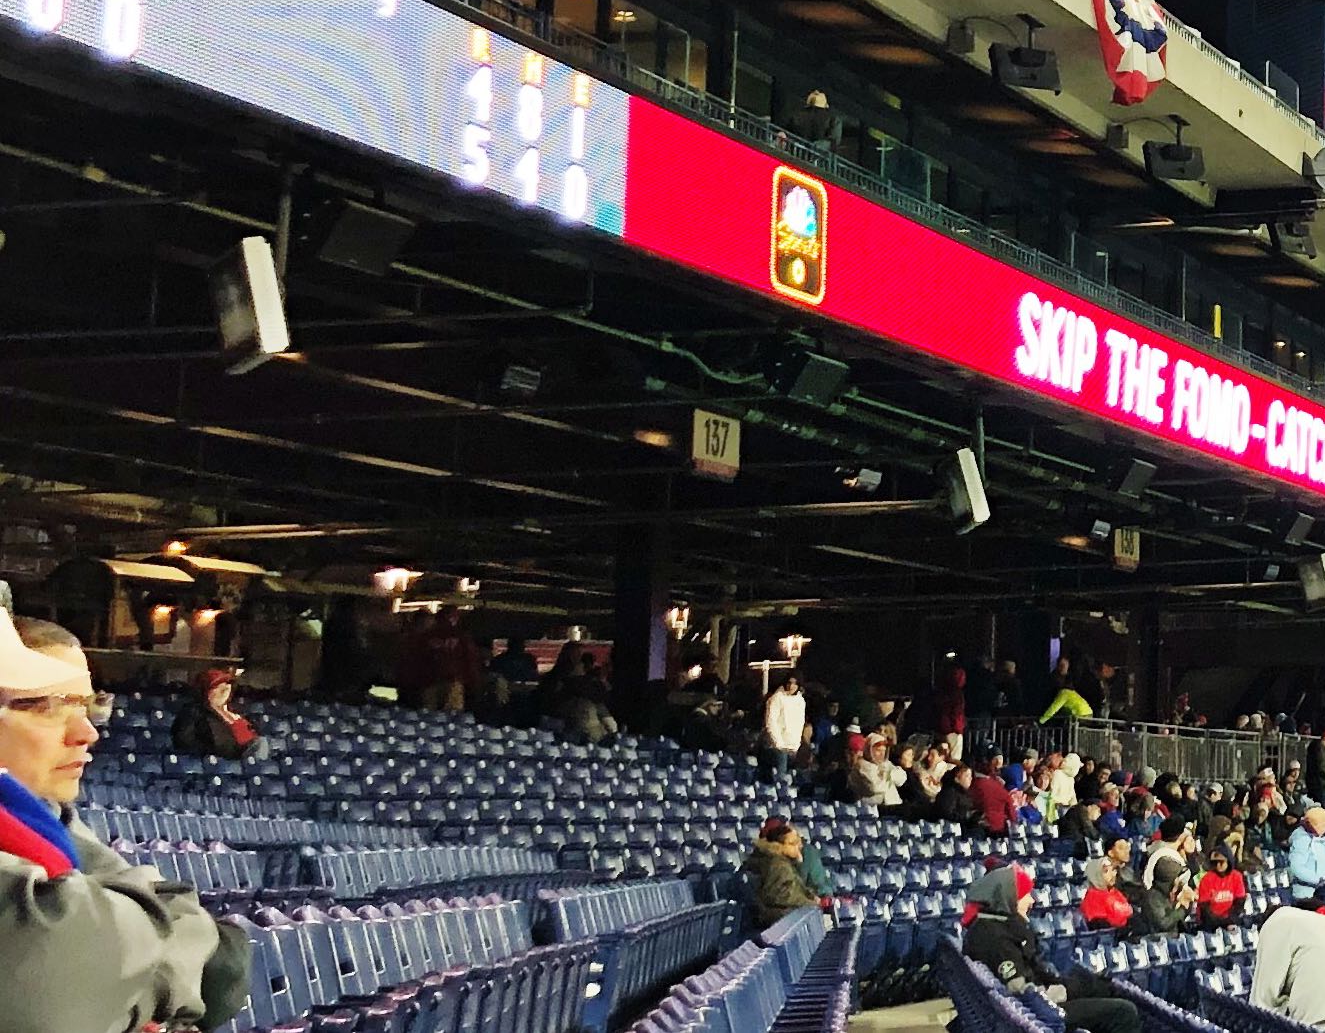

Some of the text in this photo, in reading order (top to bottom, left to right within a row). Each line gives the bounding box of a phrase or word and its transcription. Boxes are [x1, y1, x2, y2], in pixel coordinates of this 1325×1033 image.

[1015, 291, 1098, 394] SKIP
[1105, 327, 1168, 425] THE
[703, 417, 730, 459] 137
